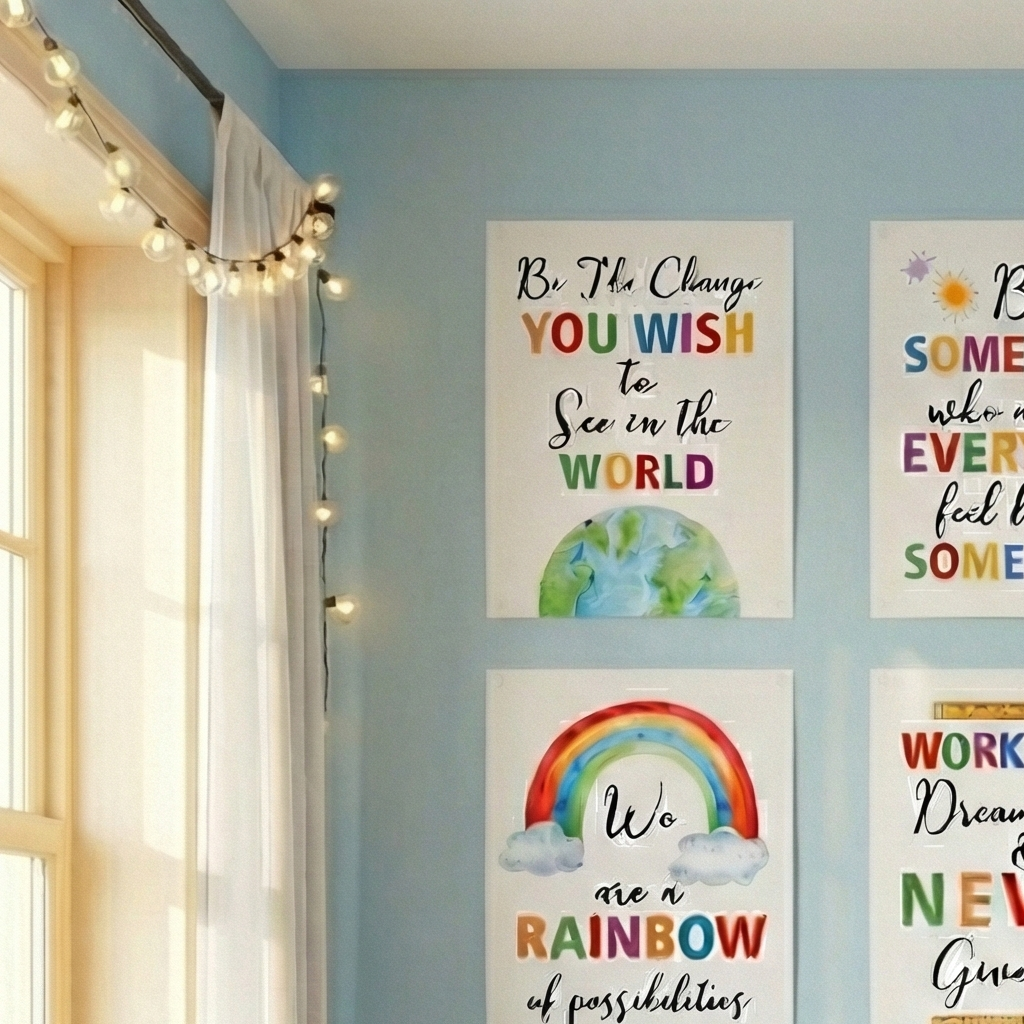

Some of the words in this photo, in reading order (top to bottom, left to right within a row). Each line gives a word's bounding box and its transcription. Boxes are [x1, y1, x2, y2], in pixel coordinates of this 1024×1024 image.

[521, 311, 616, 355] YOU
[634, 310, 754, 356] WISH
[616, 358, 658, 395] to
[559, 452, 713, 491] WORLD
[902, 731, 1024, 770] WORK
[517, 913, 767, 960] RAINBOW
